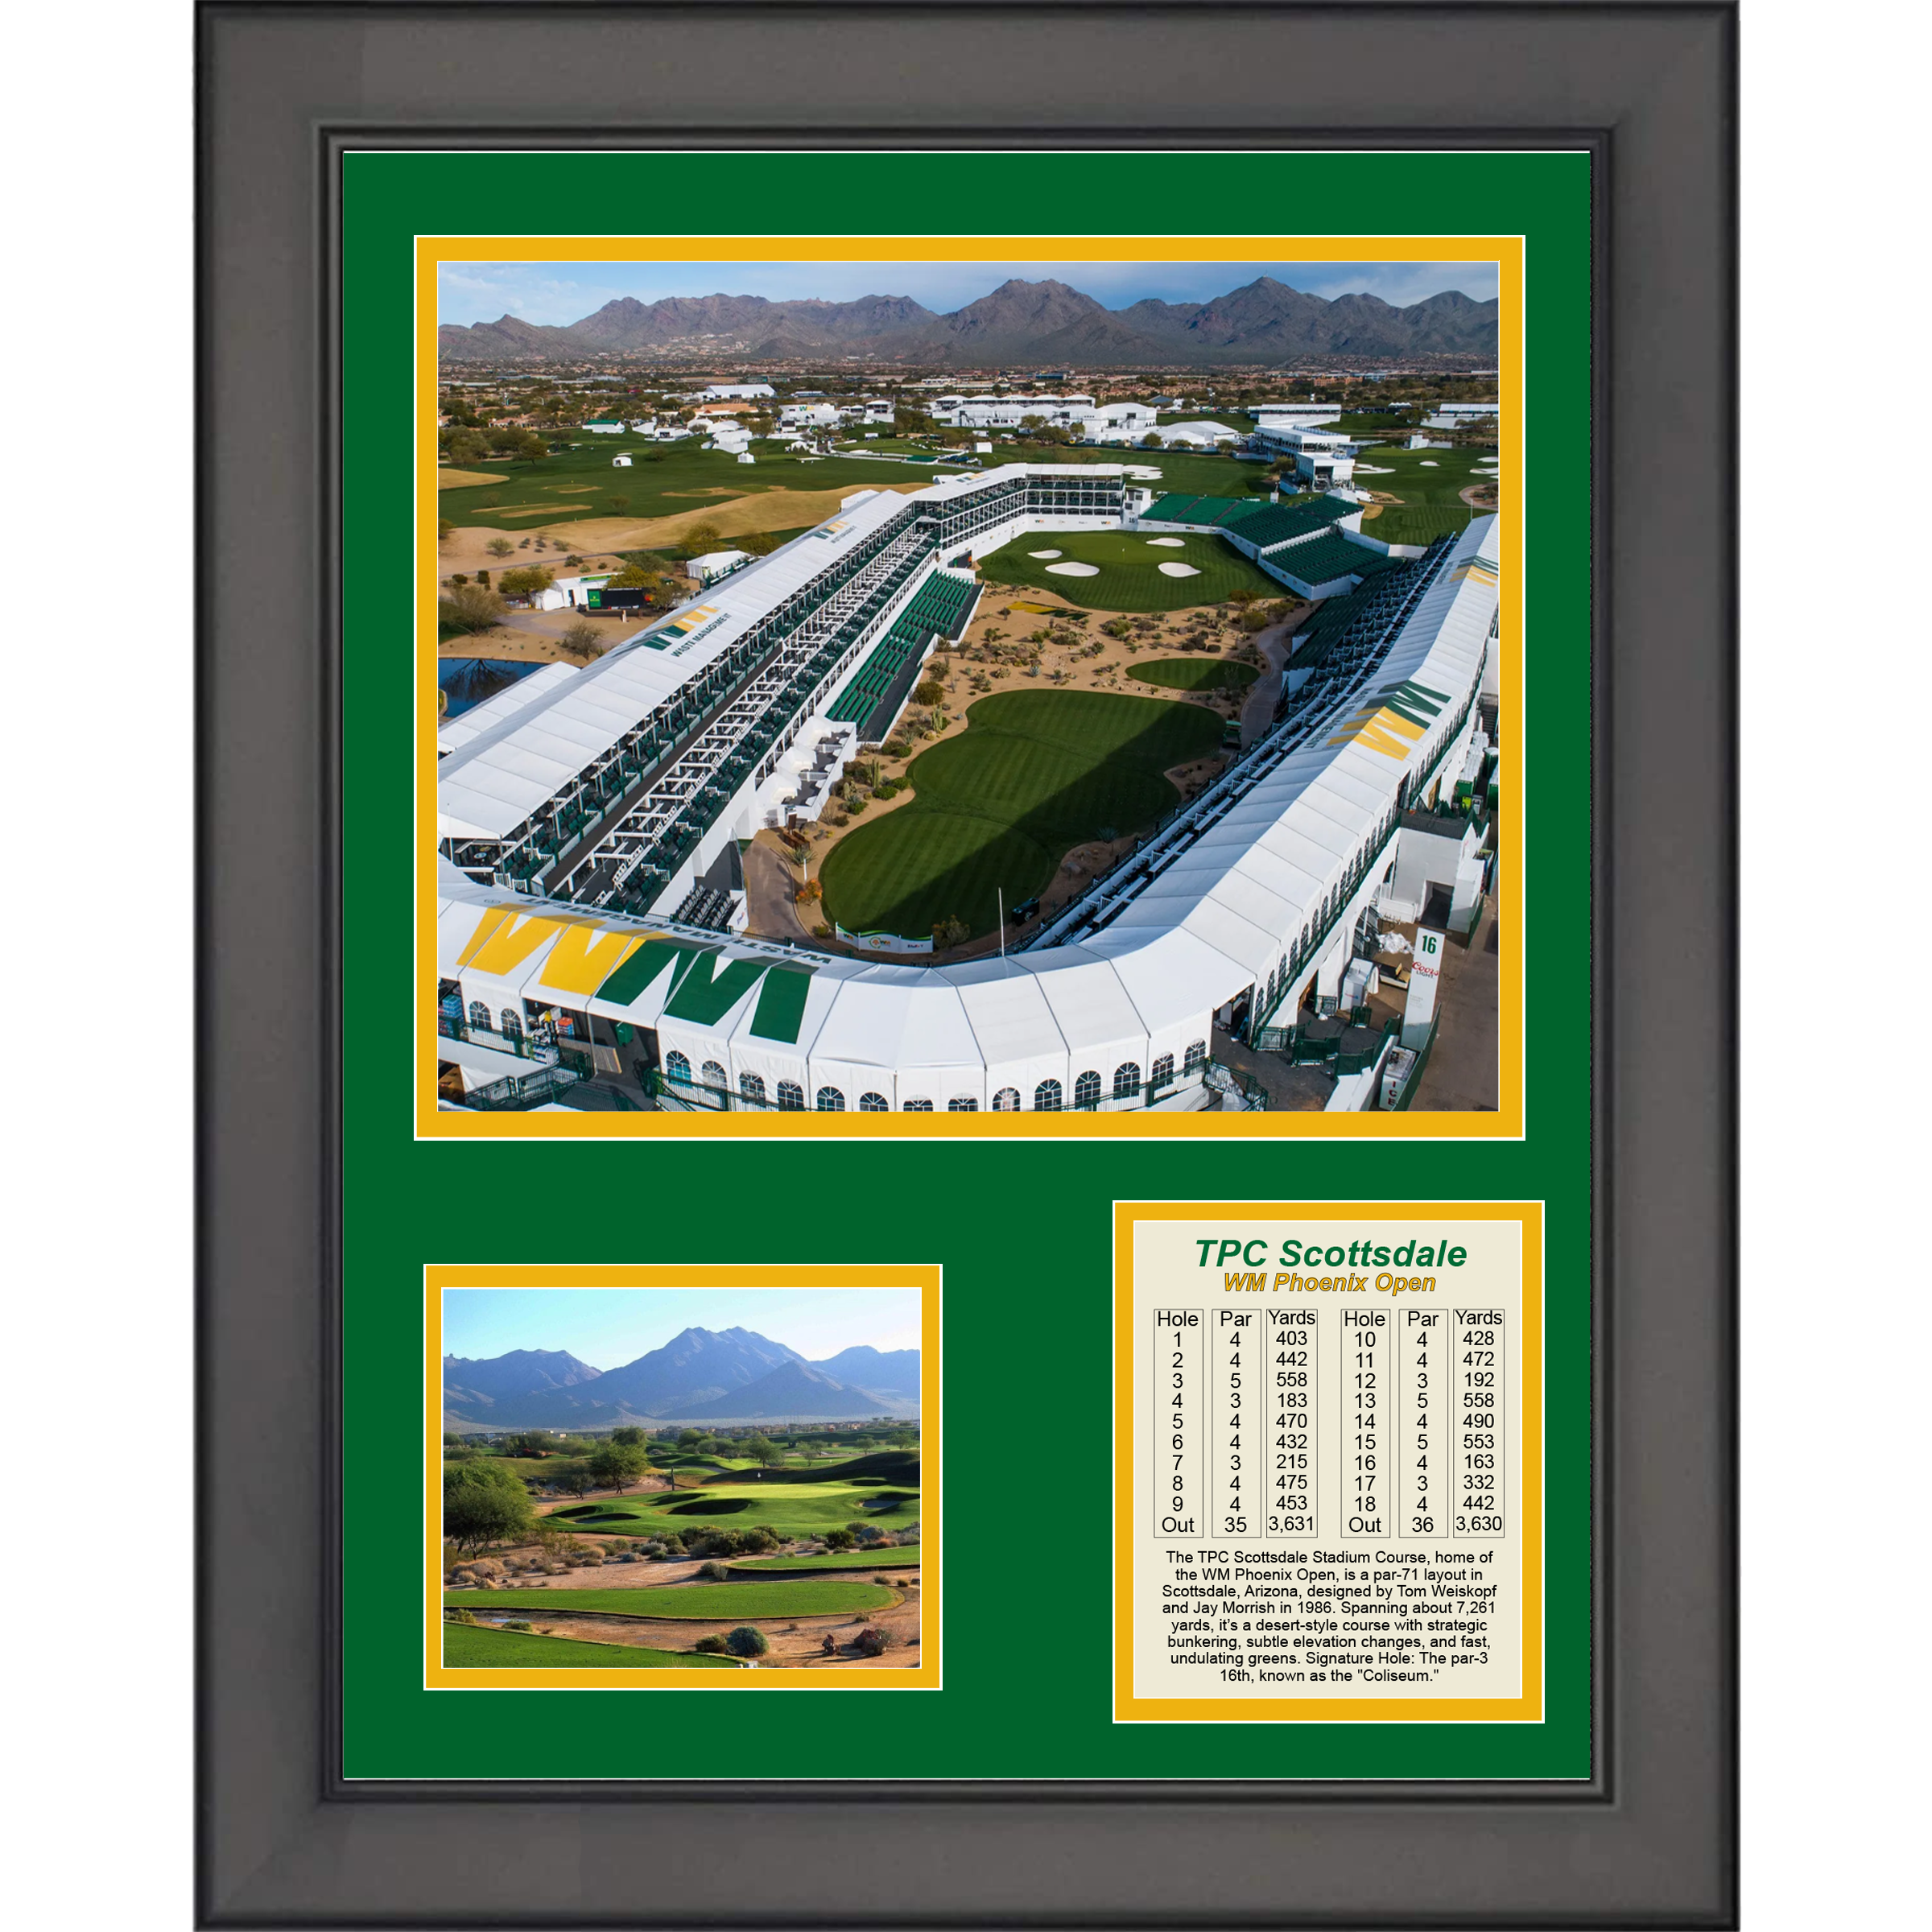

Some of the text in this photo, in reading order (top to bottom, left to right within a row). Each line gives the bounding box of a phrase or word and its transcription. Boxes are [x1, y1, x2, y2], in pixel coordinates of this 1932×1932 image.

[671, 640, 696, 658] WASTE
[1422, 935, 1437, 955] 16
[1412, 961, 1439, 976] Coors
[1416, 970, 1435, 979] LIGHT
[1387, 1080, 1397, 1106] ICE
[1195, 1239, 1468, 1267] TPC Scottsdale
[1224, 1272, 1437, 1297] WM Phoenix Open
[1158, 1310, 1316, 1327] Hole Par Yards
[1344, 1310, 1503, 1327] Hole Par Yards
[1174, 1330, 1308, 1348] 1 4 403
[1355, 1330, 1495, 1348] 10 4 428
[1172, 1351, 1308, 1368] 2 4 442
[1356, 1351, 1495, 1368] 11 4 472
[1172, 1372, 1308, 1389] 3 5 558
[1355, 1372, 1495, 1389] 12 3 192
[1171, 1392, 1308, 1409] 4 3 183
[1355, 1392, 1495, 1409] 13 5 558
[1172, 1413, 1308, 1430] 5 4 470
[1355, 1413, 1495, 1430] 14 4 490
[1172, 1434, 1308, 1451] 6 4 432
[1355, 1434, 1495, 1451] 15 5 553
[1172, 1453, 1308, 1471] 7 3 215
[1355, 1453, 1495, 1471] 16 4 163
[1172, 1474, 1308, 1492] 8 4 475
[1355, 1474, 1495, 1492] 17 3 332
[1172, 1495, 1308, 1513] 9 4 453
[1355, 1495, 1495, 1513] 18 4 442
[1161, 1515, 1313, 1534] Out 35 3,631
[1348, 1515, 1503, 1534] Out 36 3,630
[1166, 1550, 1494, 1566] The TPC Scottsdale Stadium Course, home of
[1174, 1567, 1483, 1584] the WM Phoenix Open, is a par-71 layout in
[1162, 1584, 1498, 1601] Scottsdale, Arizona, designed by Tom Weiskopf
[1162, 1600, 1495, 1617] and Jay Morrish in 1986. Spanning about 7,261
[1170, 1618, 1214, 1635] yards,
[1242, 1621, 1252, 1632] a
[1255, 1618, 1339, 1635] desert-style
[1342, 1621, 1390, 1632] course
[1393, 1618, 1422, 1632] with
[1426, 1618, 1488, 1635] strategic
[1167, 1634, 1491, 1651] bunkering, subtle elevation changes, and fast,
[1170, 1651, 1488, 1668] undulating greens. Signature Hole: The par-3
[1220, 1668, 1439, 1684] 16th, known as the "Coliseum."
